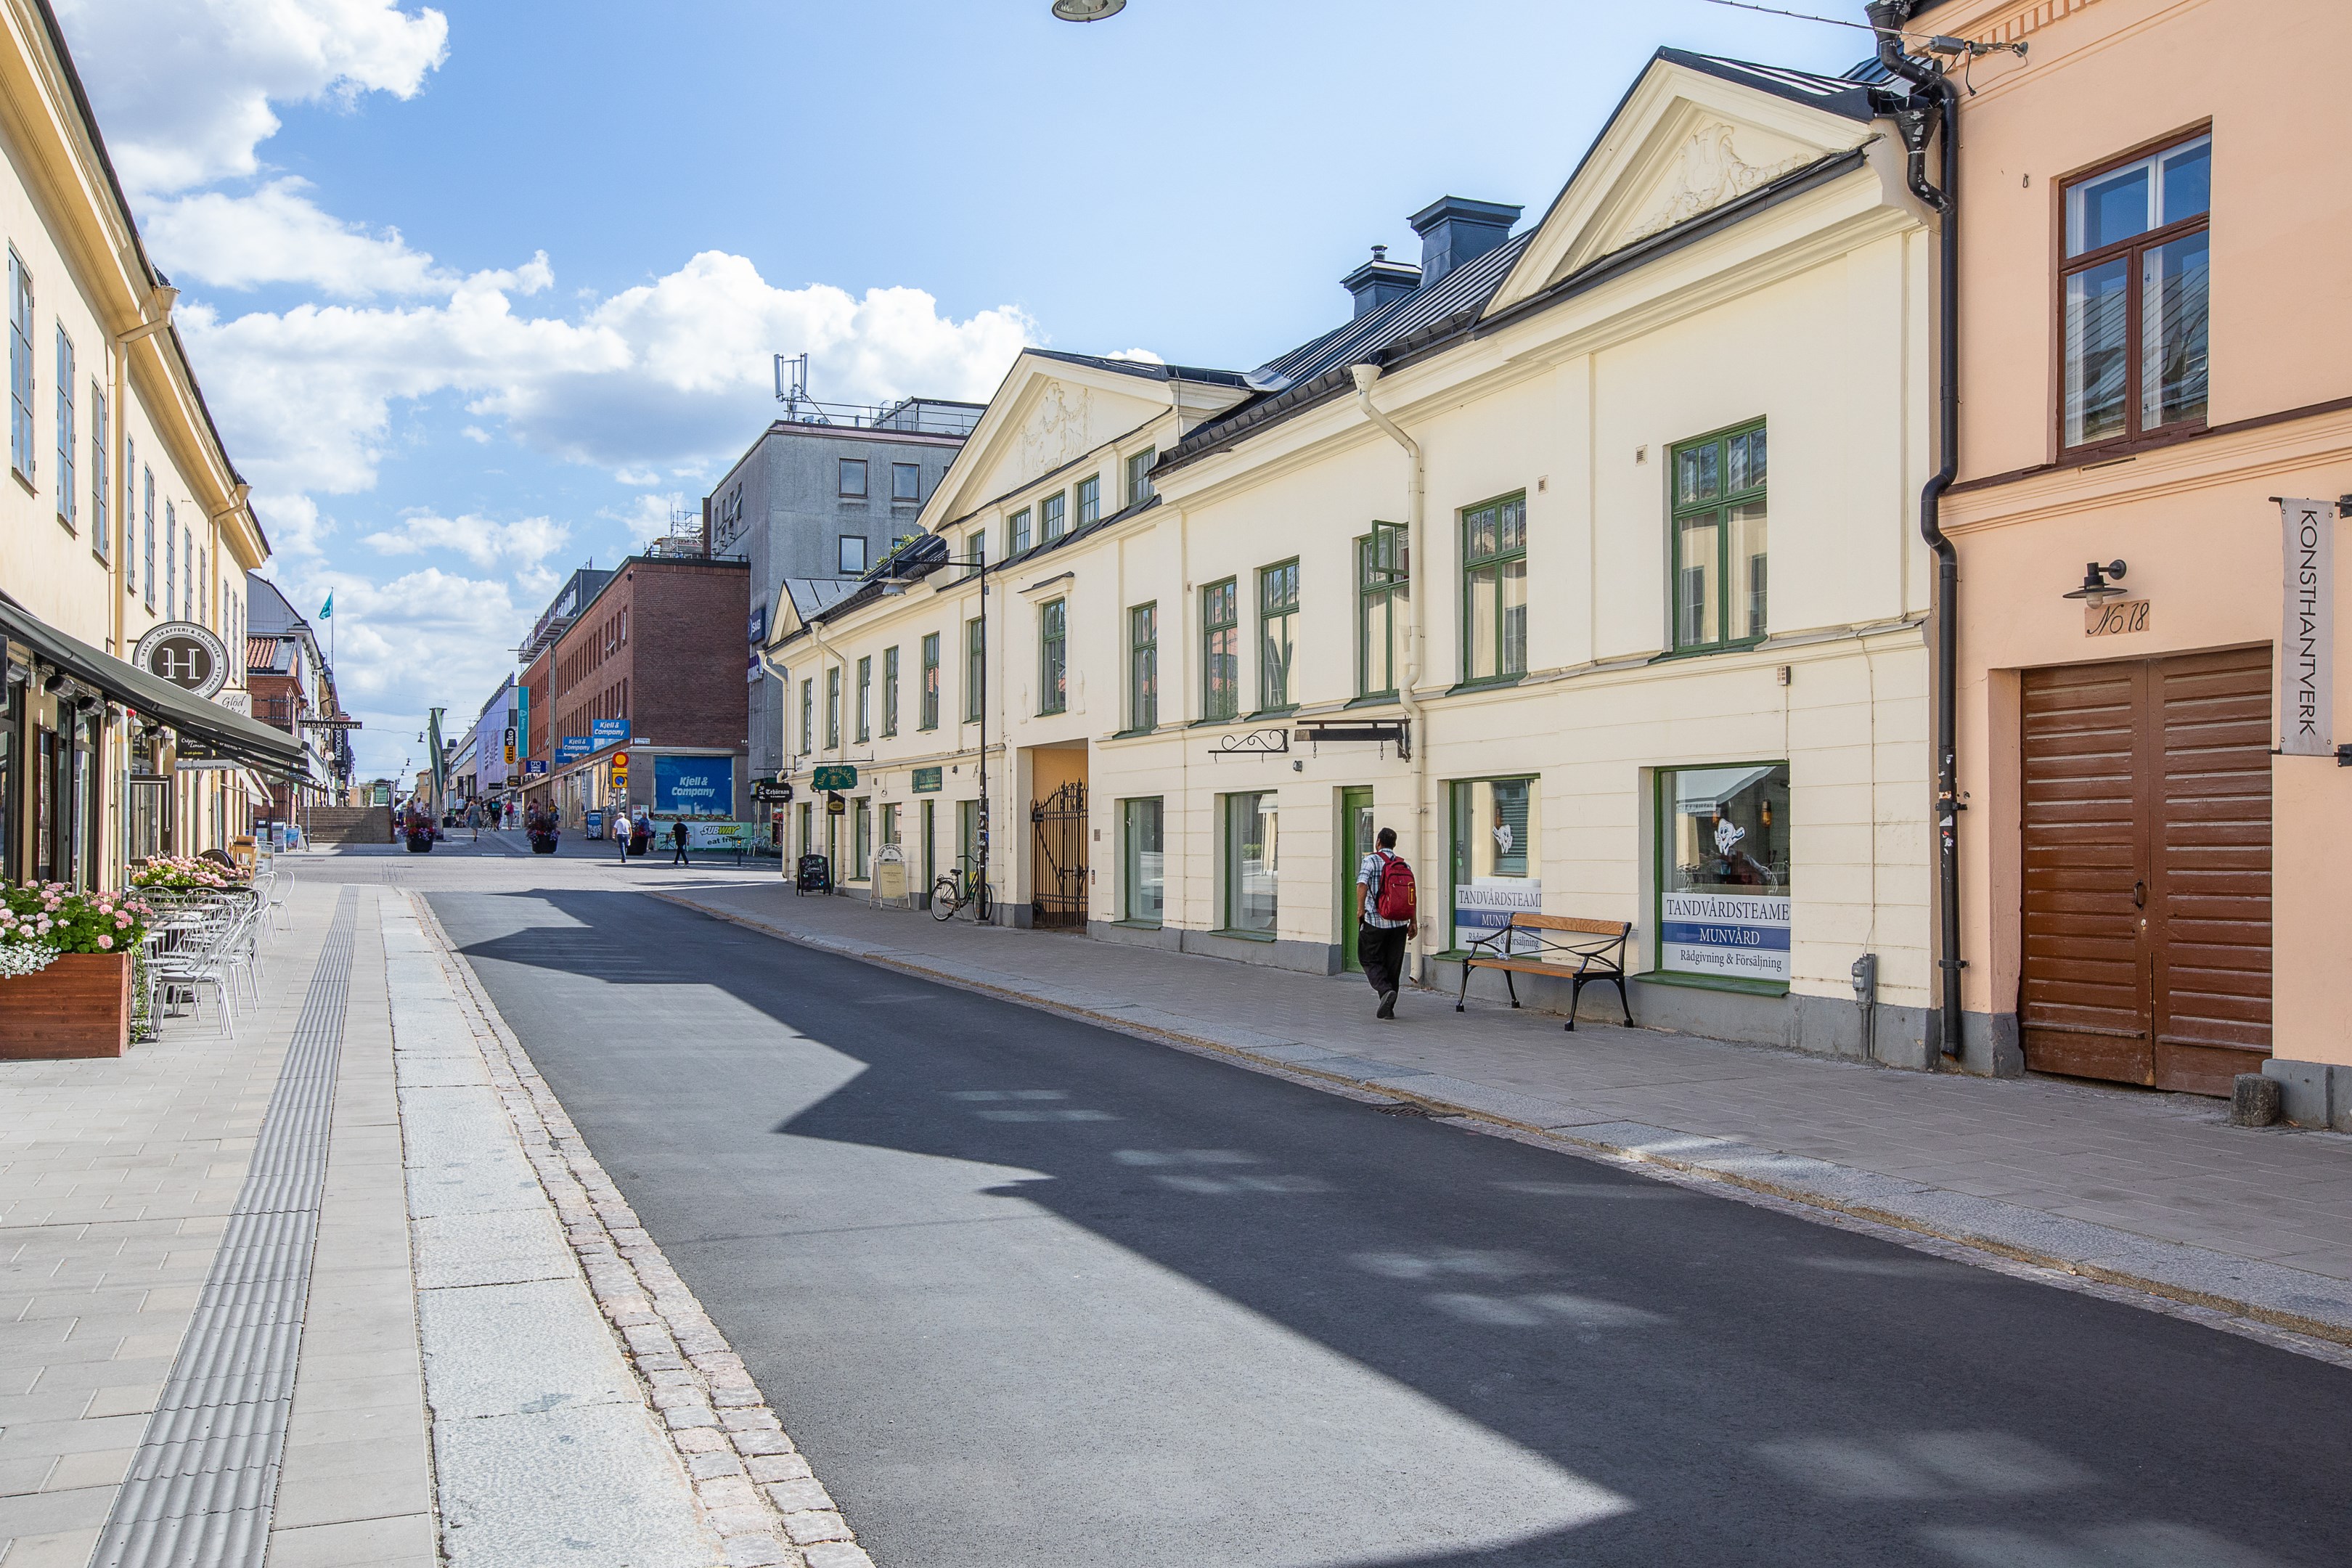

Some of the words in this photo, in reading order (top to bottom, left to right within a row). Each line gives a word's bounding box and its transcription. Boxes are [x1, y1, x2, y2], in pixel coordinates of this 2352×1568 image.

[2128, 603, 2149, 632] 18
[2299, 510, 2318, 735] KONSTHANTVERK
[142, 641, 152, 656] HAVA
[157, 627, 189, 638] SKAFFERI
[197, 632, 221, 658] SALONGER
[163, 648, 200, 679] H
[205, 666, 222, 691] UPPSALA
[221, 695, 246, 709] Glöd
[334, 730, 343, 761] interpool
[679, 776, 701, 787] Kjell
[701, 777, 708, 785] &
[817, 773, 828, 785] Alan
[828, 767, 853, 785] Skrädderi
[671, 787, 715, 797] Company
[700, 825, 740, 836] SUBWAY
[886, 846, 903, 857] Skrädderi
[1667, 897, 1790, 920] TANDVÅRDSTEAME
[1500, 935, 1506, 944] &
[1509, 936, 1539, 950] örsäljning
[1699, 926, 1760, 945] MUNVÅRD
[1681, 950, 1725, 968] Rådgivning
[1726, 952, 1734, 965] &
[1736, 953, 1782, 972] Försäljning
